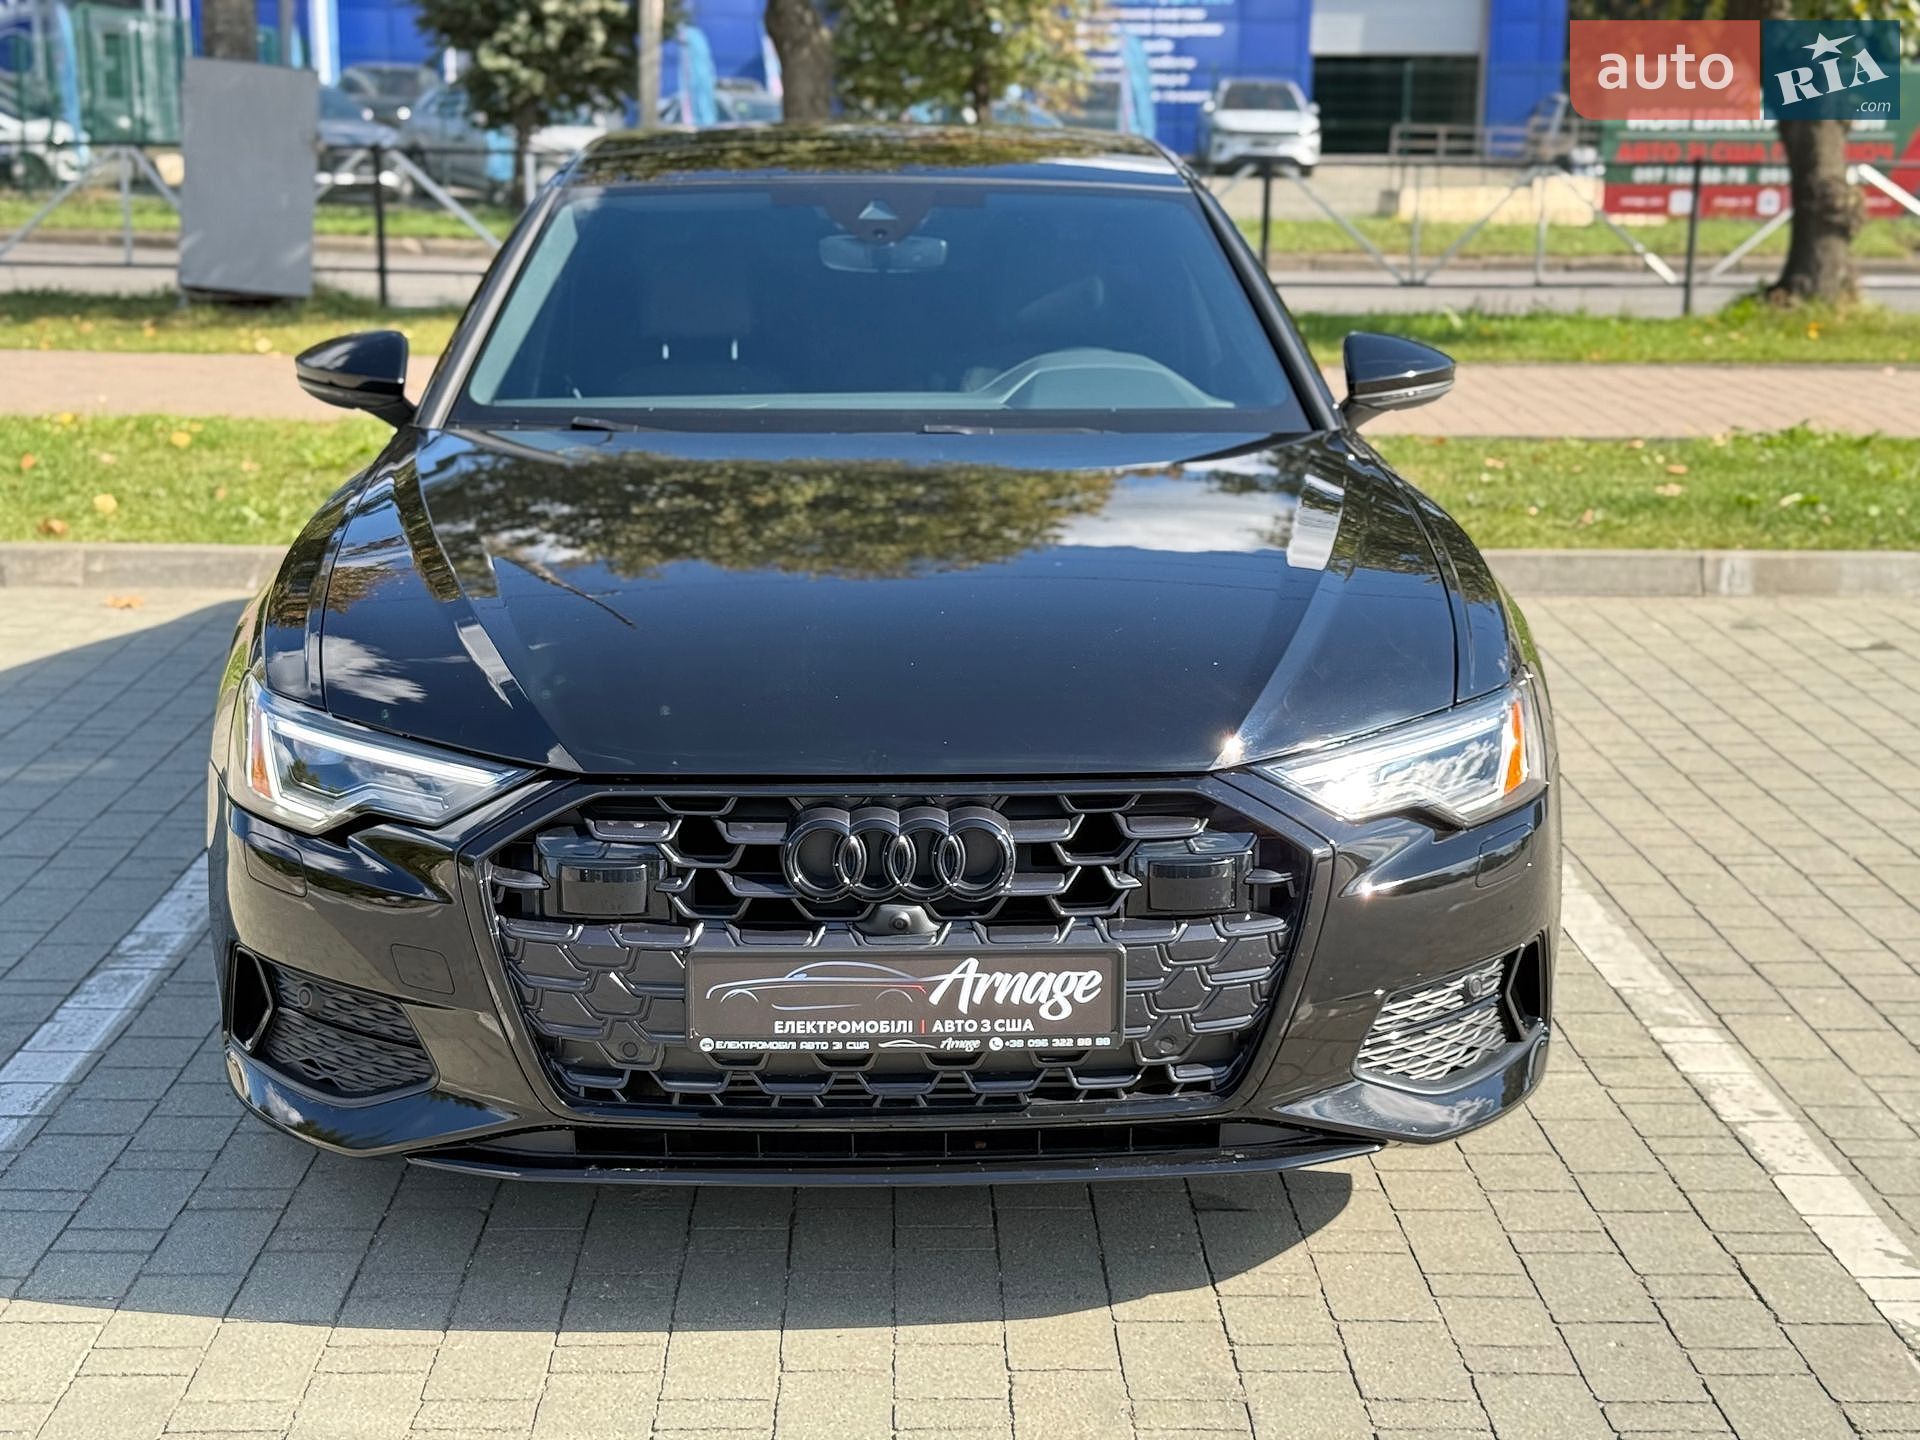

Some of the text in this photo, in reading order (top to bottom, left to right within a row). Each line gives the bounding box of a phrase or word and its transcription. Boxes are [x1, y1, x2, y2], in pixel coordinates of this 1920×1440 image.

[929, 957, 1103, 1021] Arnage
[774, 1019, 913, 1034] ЕЛЕКТРОМОБІЛІ
[932, 1019, 978, 1033] АВТО
[994, 1018, 1035, 1033] США
[800, 1041, 829, 1050] АВТО
[846, 1041, 870, 1050] США
[940, 1037, 982, 1052] Arnage
